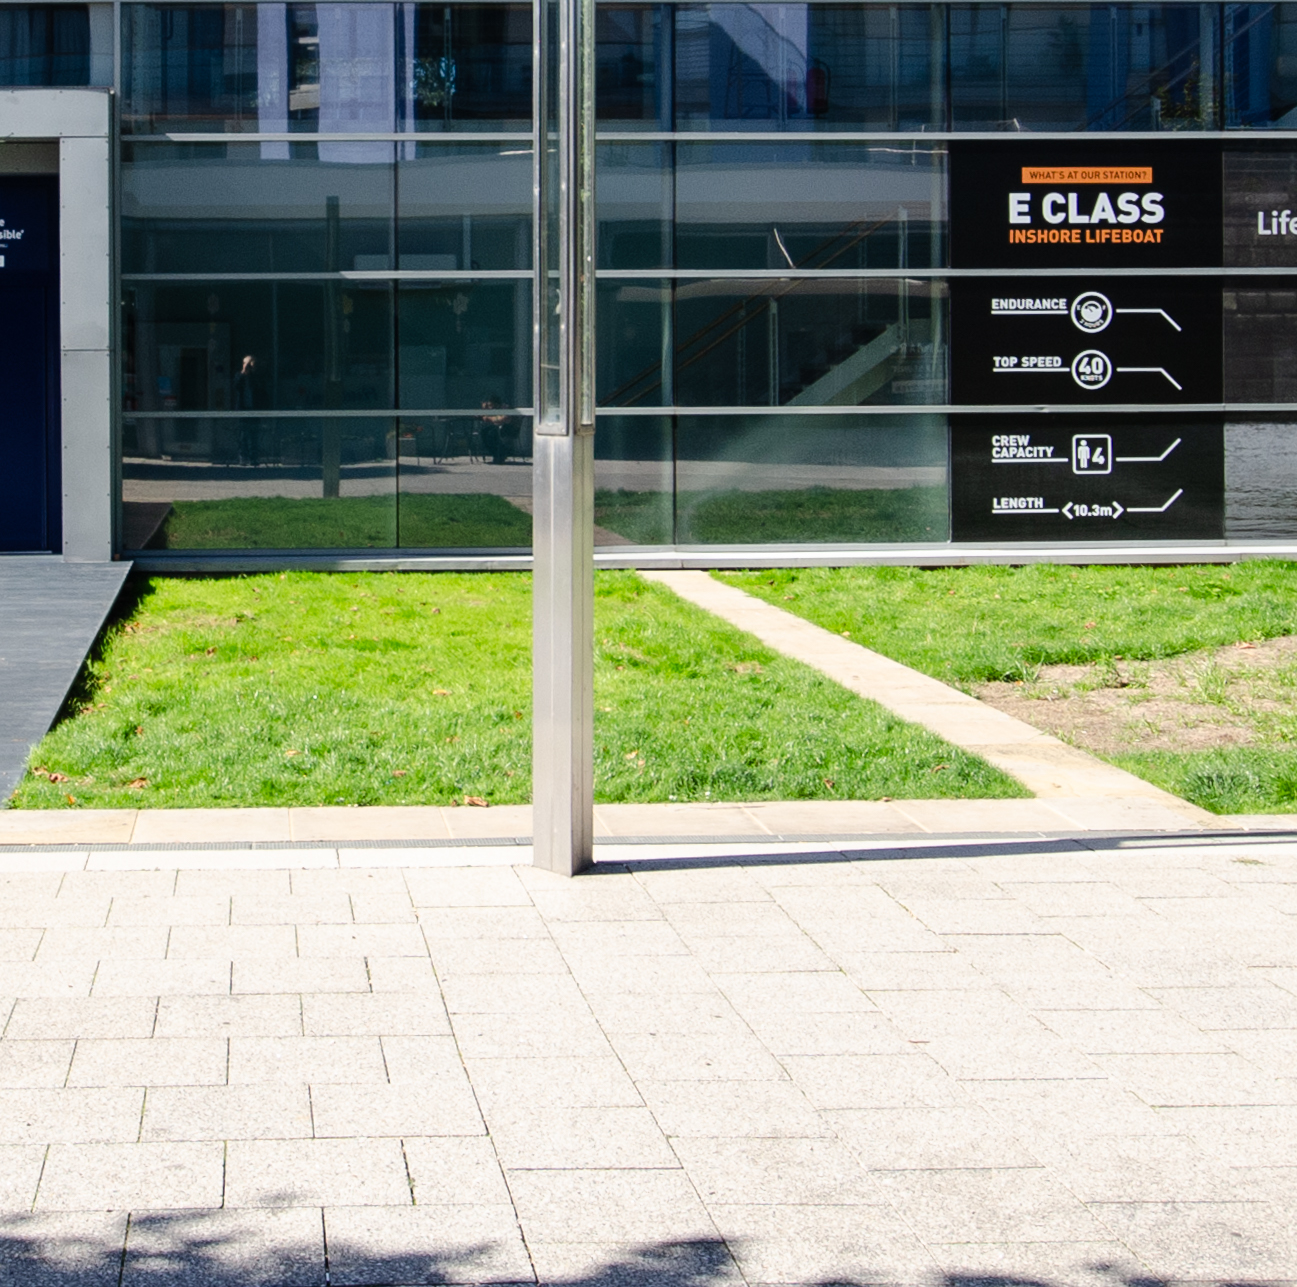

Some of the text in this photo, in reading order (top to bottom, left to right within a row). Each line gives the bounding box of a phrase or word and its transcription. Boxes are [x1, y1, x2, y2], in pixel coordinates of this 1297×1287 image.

[1029, 171, 1147, 179] WHAT'S AT OUR STATION?
[1009, 192, 1165, 224] E CLASS
[1009, 229, 1164, 244] INSHORE LIFEBOAT
[991, 298, 1067, 310] ENDURANCE
[993, 357, 1062, 368] TOP SPEED
[1078, 356, 1104, 375] 40
[992, 435, 1030, 446] CREW
[992, 446, 1054, 458] CAPACITY
[1092, 447, 1105, 465] 4
[993, 497, 1043, 509] LENGTH
